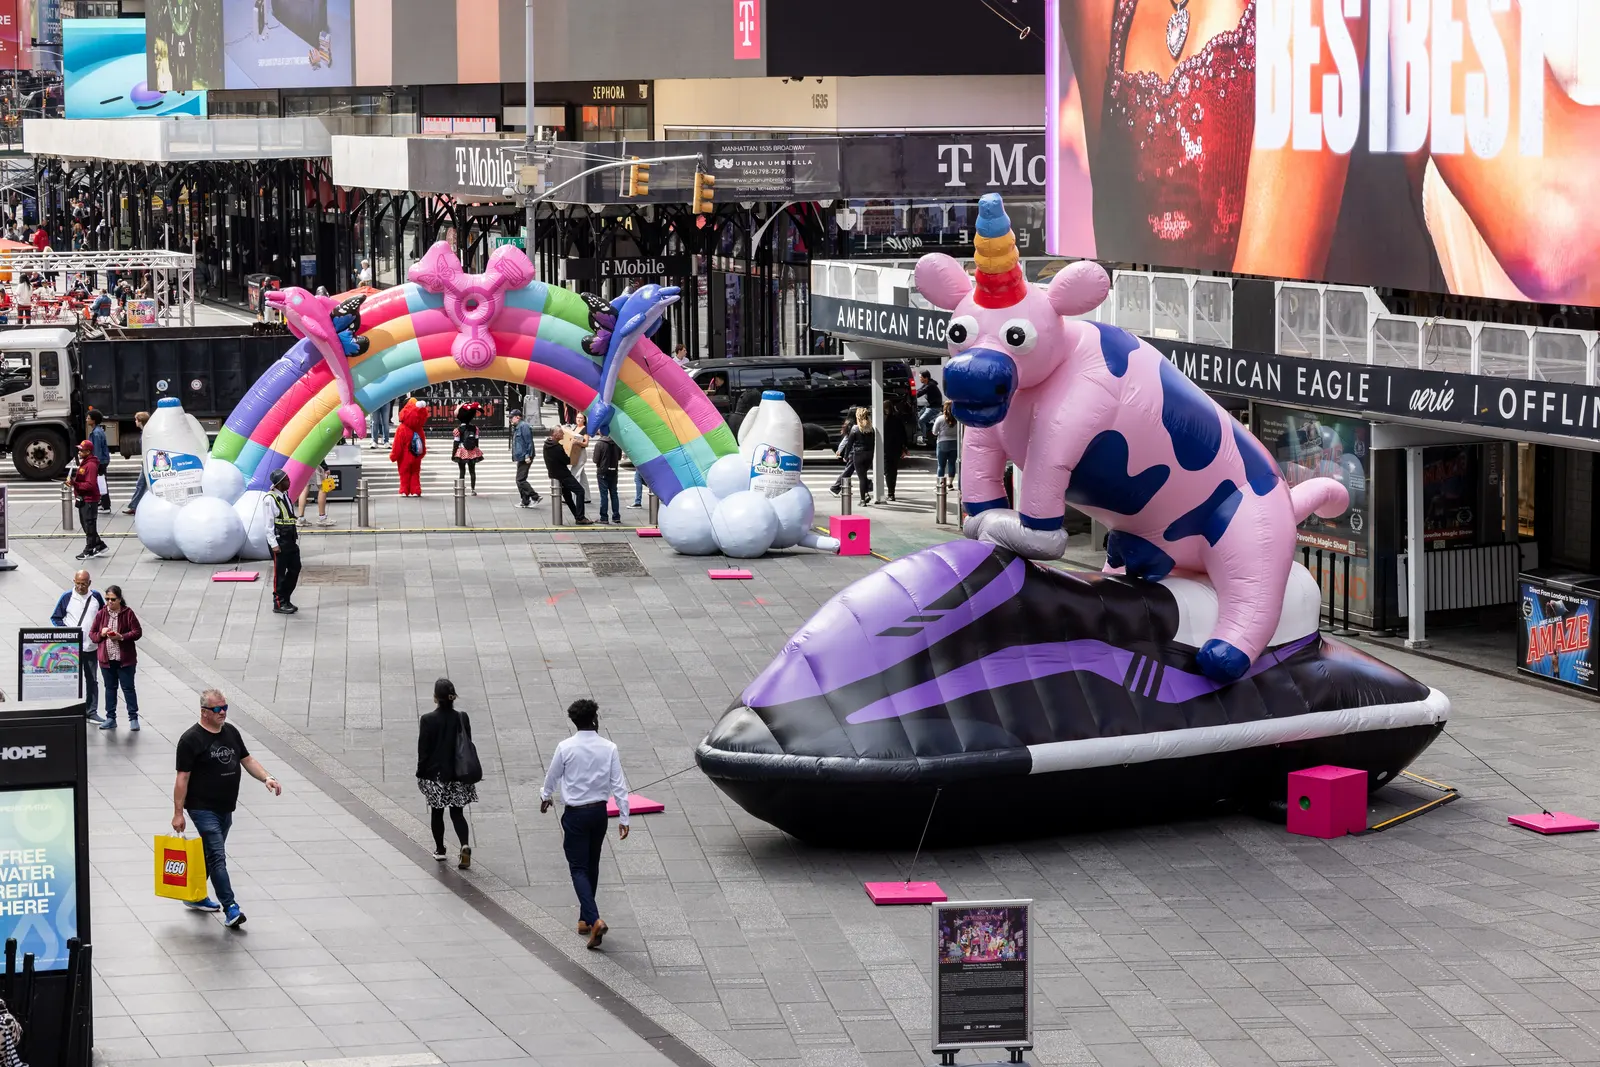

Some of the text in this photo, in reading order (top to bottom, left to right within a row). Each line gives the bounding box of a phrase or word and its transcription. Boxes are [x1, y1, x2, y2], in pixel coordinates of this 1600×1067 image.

[593, 86, 625, 99] SEPHORA
[811, 94, 829, 109] 1535
[508, 238, 517, 247] 46
[613, 259, 665, 275] Mobile
[837, 305, 947, 342] AMERICAN EAG
[1170, 350, 1280, 391] AMERICAN
[1297, 366, 1370, 403] EAGLE
[1409, 379, 1455, 412] aerie
[1296, 533, 1348, 551] Favorite Magic Show
[1529, 586, 1589, 606] Direct From London's West End
[1526, 613, 1590, 664] AMAZE
[0, 848, 47, 865] FREE
[164, 859, 187, 876] LEGO
[0, 899, 49, 916] HERE
